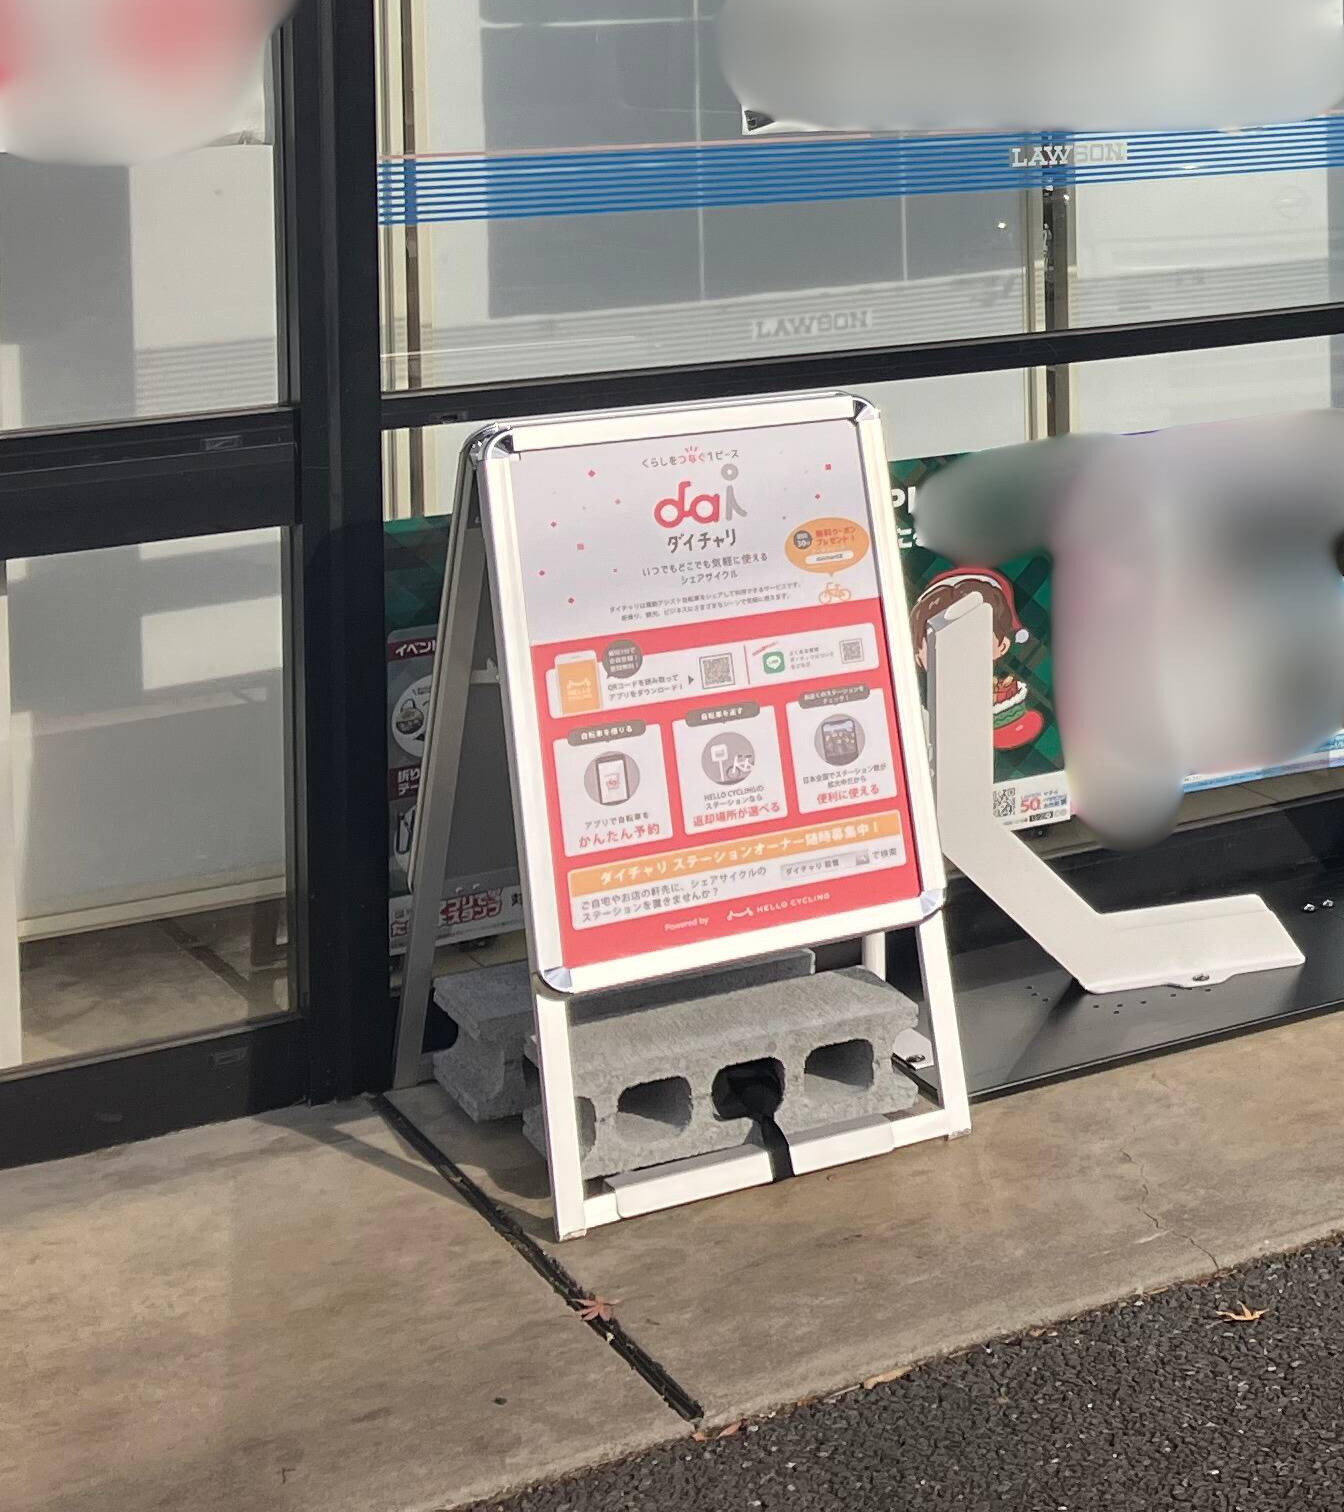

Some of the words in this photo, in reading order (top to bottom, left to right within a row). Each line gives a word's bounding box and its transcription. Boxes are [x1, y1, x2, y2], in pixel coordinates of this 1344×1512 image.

[1010, 142, 1127, 169] LAWSON
[641, 448, 740, 469] くらしをつなぐ1ピース
[667, 528, 737, 554] ダイチャリ
[641, 551, 768, 578] いつでもどこでも気軽に使える
[680, 570, 738, 586] シェアサイクル
[816, 784, 880, 805] 便利に使える
[584, 811, 649, 829] アプリで自転車を
[692, 801, 781, 827] 返却場所が選べる
[578, 823, 660, 848] かんたん予約
[600, 860, 668, 885] ダイチャリ
[756, 900, 789, 914] HELLO
[789, 892, 831, 907] CYCLING
[664, 917, 698, 932] Powered
[698, 915, 710, 927] by
